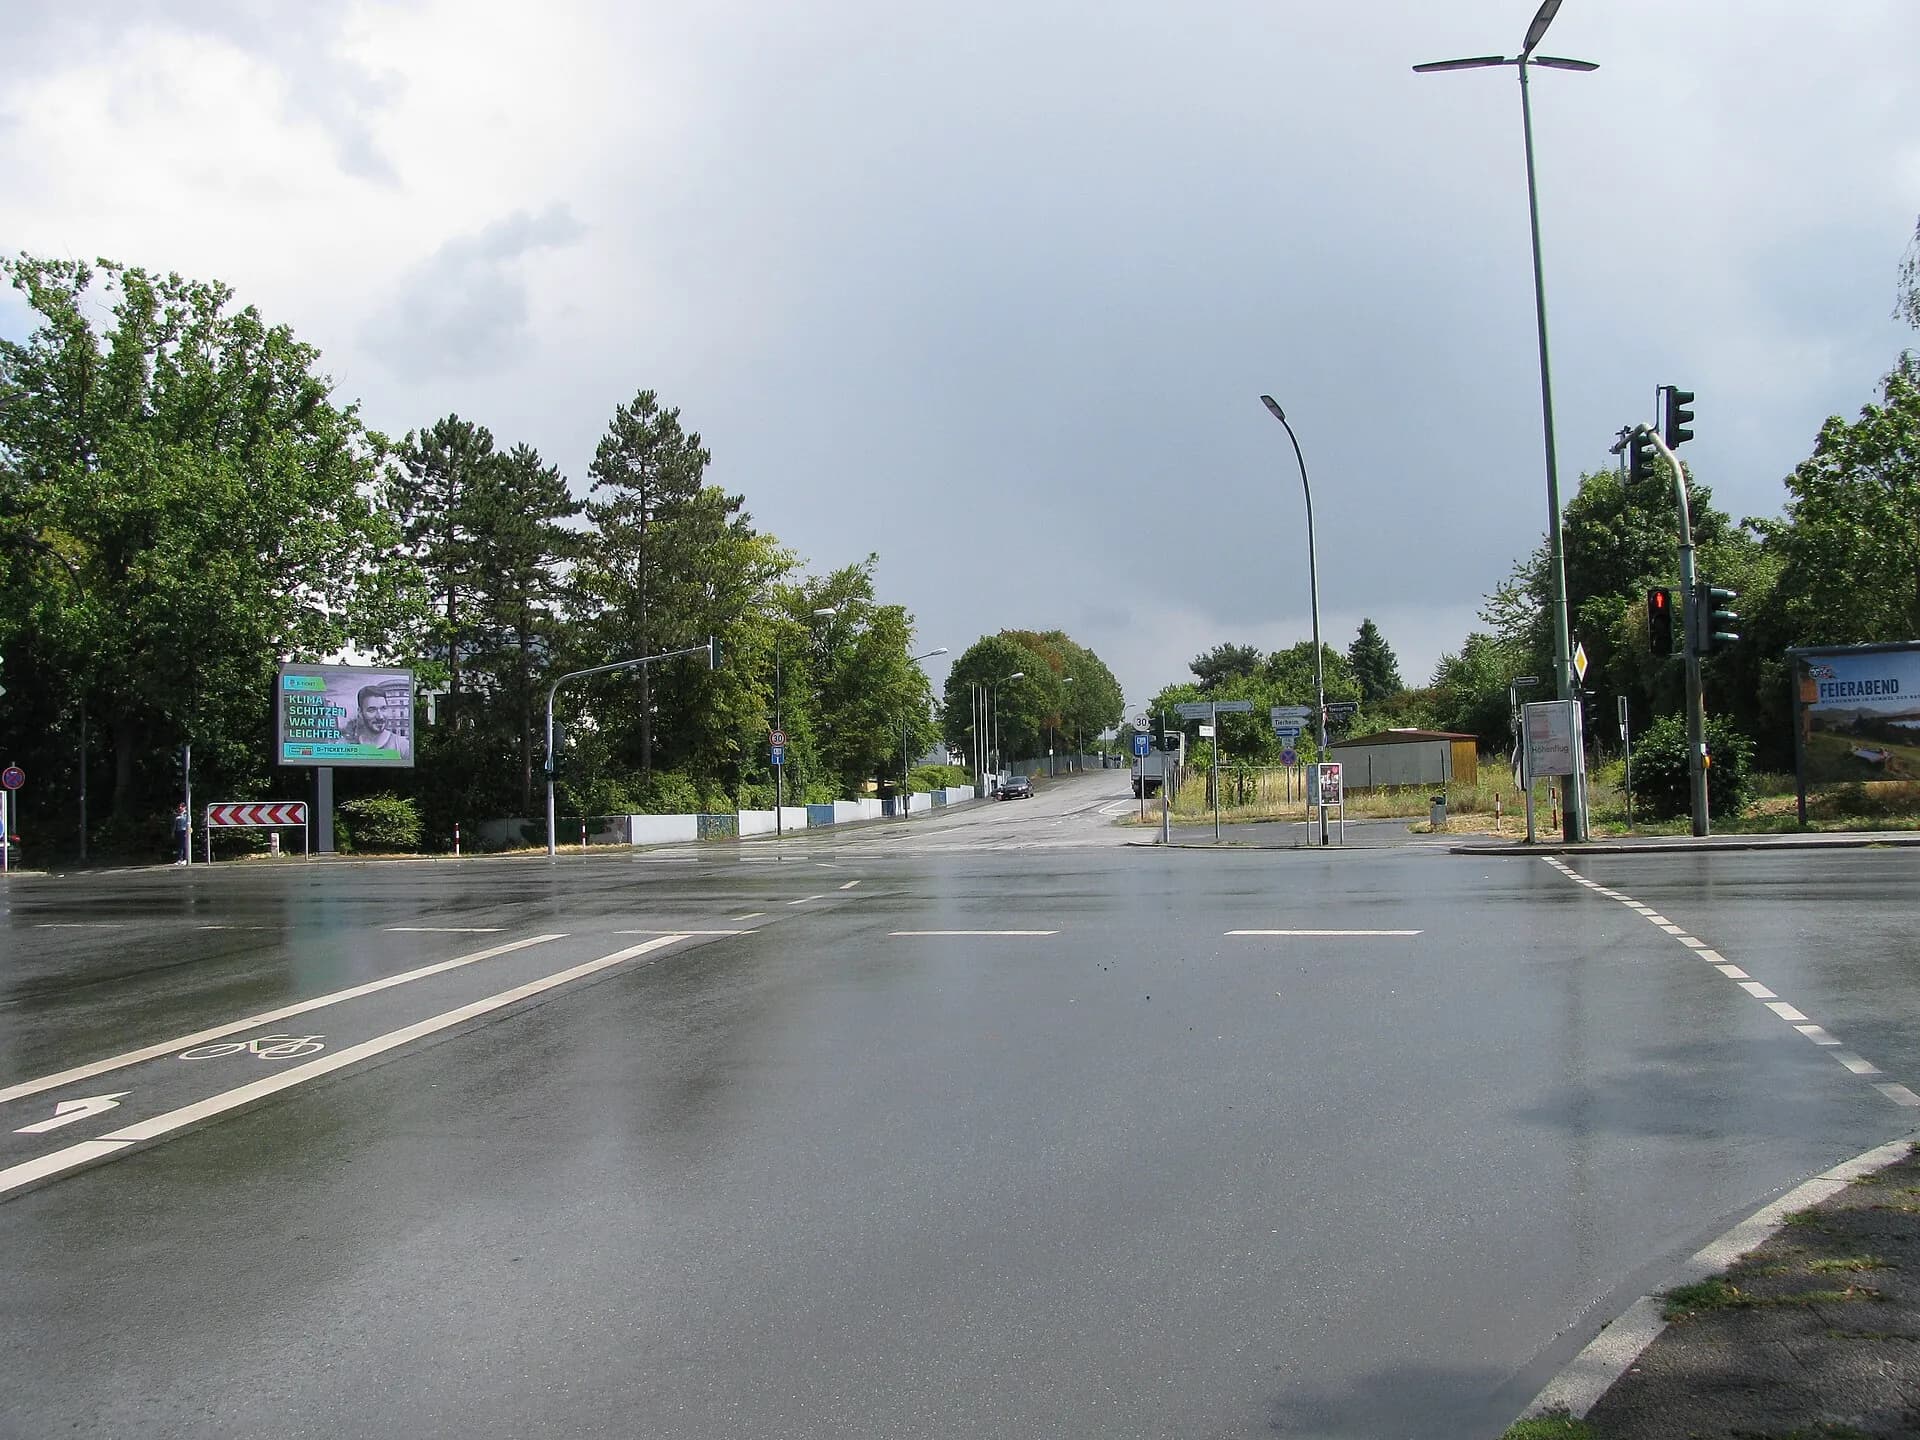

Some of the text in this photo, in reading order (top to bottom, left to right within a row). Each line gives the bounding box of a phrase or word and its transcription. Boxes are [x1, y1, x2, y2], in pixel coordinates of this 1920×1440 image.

[1820, 679, 1899, 698] FEIERABEND
[289, 695, 323, 704] KLIMA
[289, 704, 345, 716] SCHÜTZEN
[289, 717, 336, 728] WAR NIE
[1136, 718, 1147, 727] 30
[289, 729, 344, 739] LEICHTER.
[773, 734, 783, 743] 30
